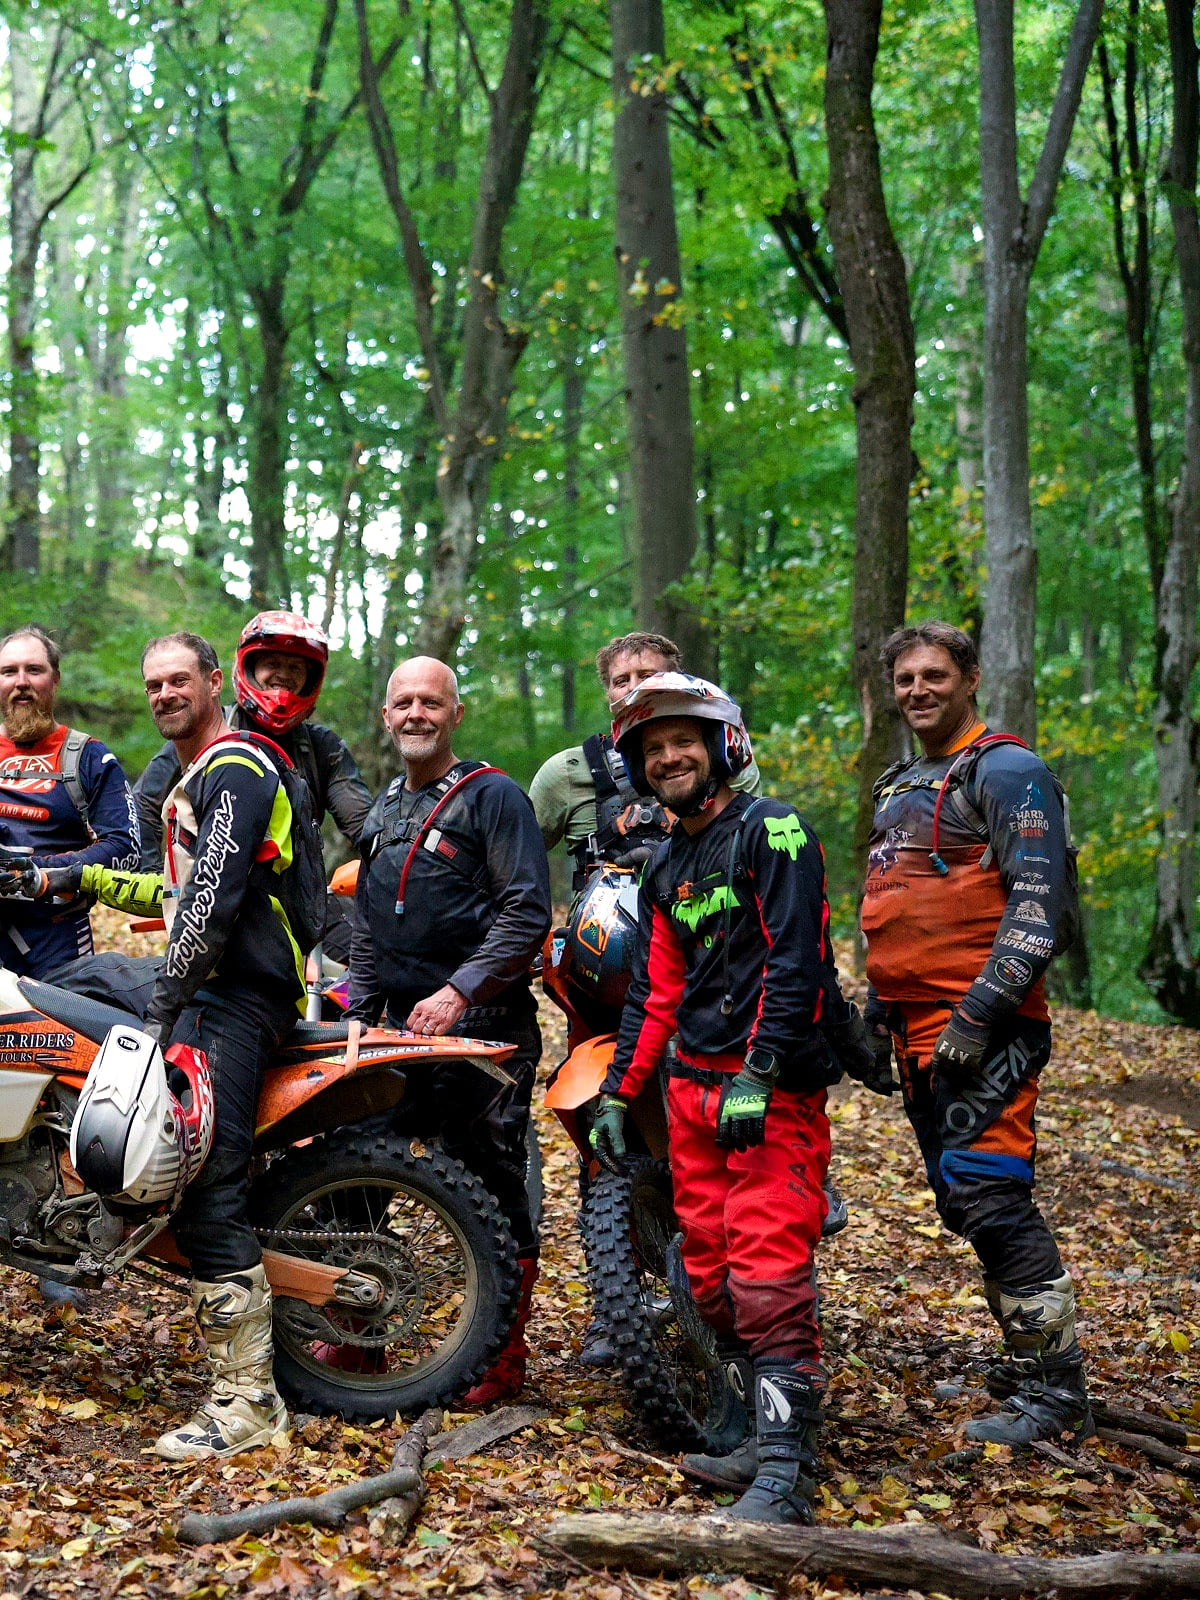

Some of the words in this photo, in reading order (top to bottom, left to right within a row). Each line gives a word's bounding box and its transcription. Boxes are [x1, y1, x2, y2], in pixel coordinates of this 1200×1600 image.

[21, 808, 45, 819] PRIX
[1016, 809, 1044, 821] HARD
[1008, 819, 1049, 833] ENDURO
[196, 790, 240, 889] Designs
[184, 888, 215, 936] Lee
[998, 936, 1053, 958] EXPERIENCE
[1026, 934, 1054, 948] MOTO
[167, 928, 211, 979] Troy
[19, 1033, 74, 1049] RIDERS
[358, 1045, 432, 1060] MICHELIN
[938, 1040, 970, 1065] FLY
